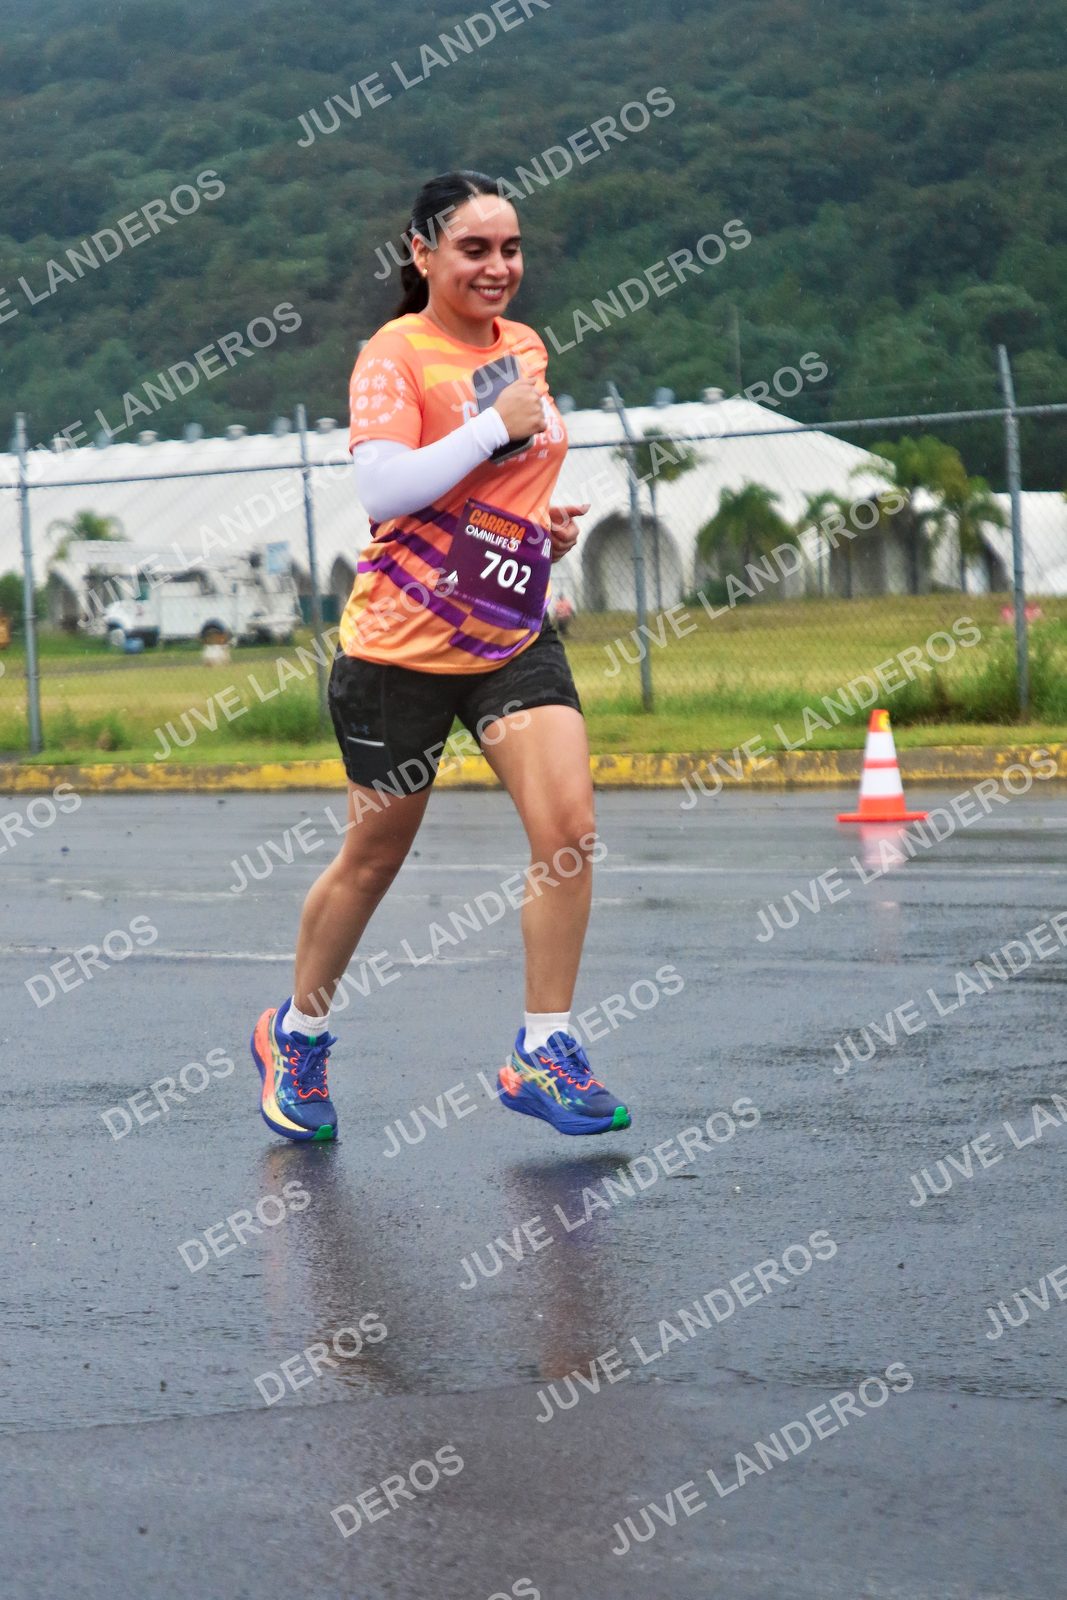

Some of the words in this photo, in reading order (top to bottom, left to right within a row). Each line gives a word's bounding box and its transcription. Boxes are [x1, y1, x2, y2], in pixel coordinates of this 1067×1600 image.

[465, 524, 509, 549] OMNILIFE
[469, 509, 526, 541] CARRERA
[480, 550, 532, 595] 702
